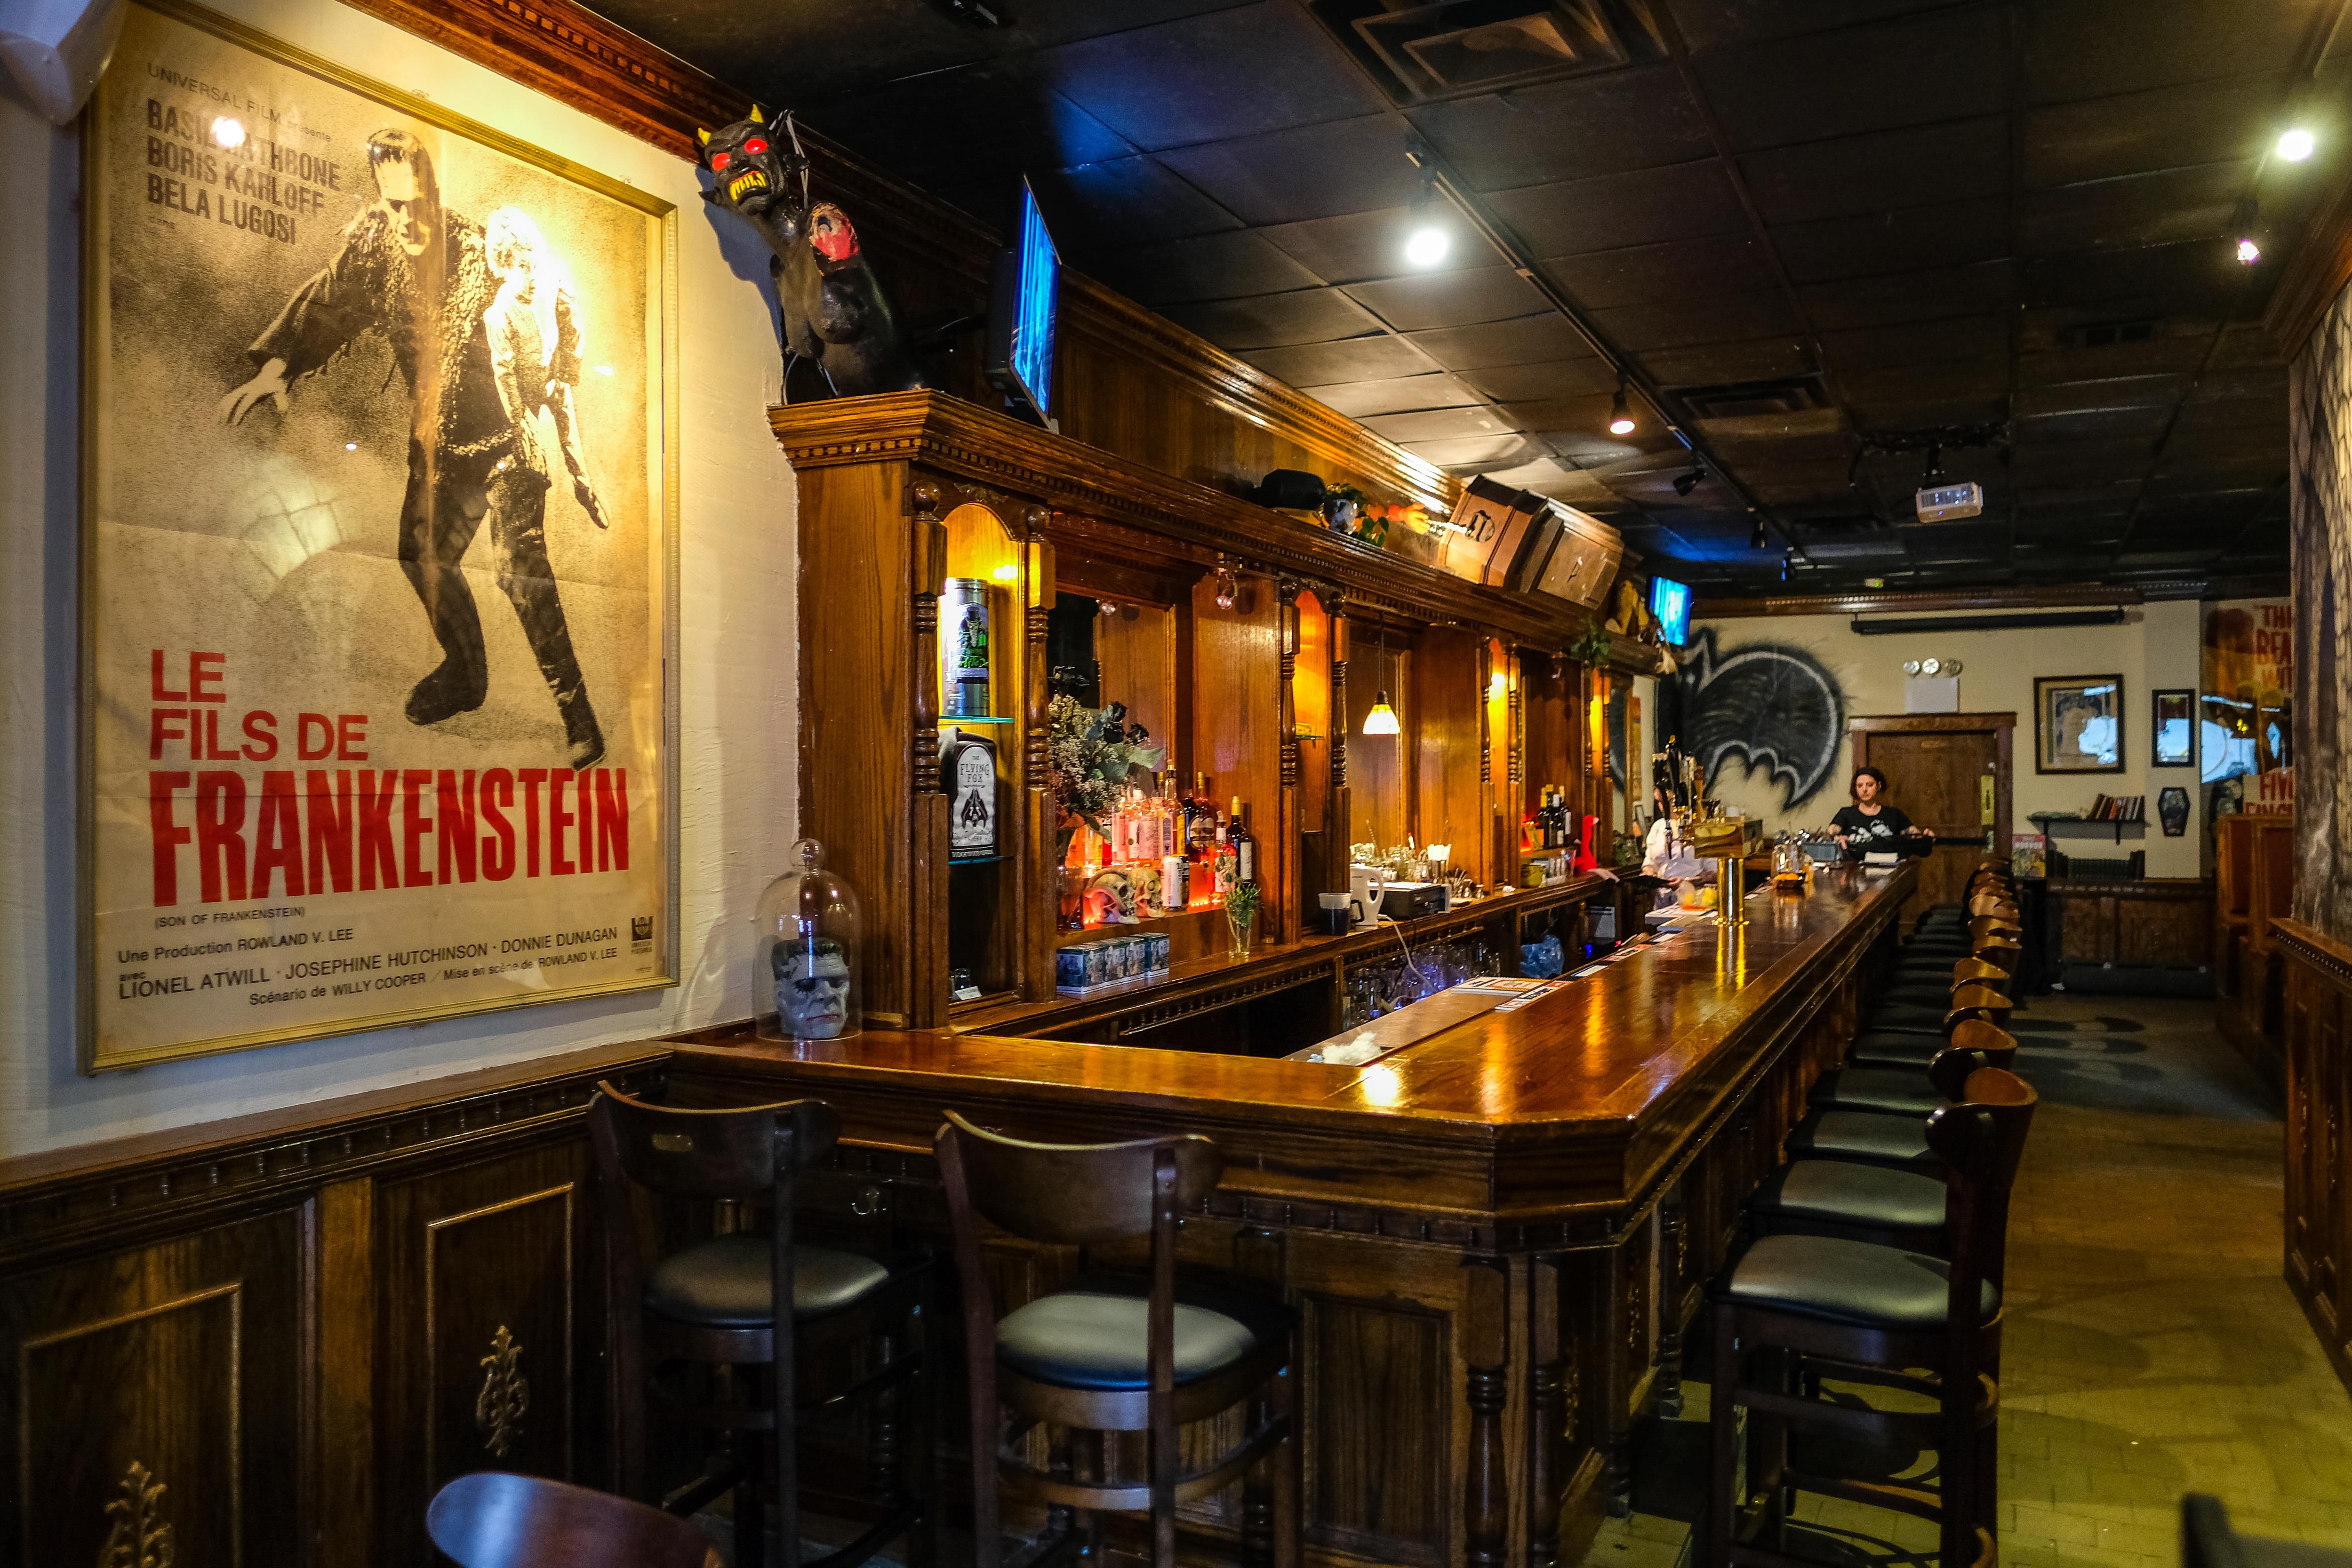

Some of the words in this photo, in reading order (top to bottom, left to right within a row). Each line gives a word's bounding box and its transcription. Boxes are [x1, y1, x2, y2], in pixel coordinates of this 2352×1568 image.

[147, 62, 241, 109] UNIVERSAL
[246, 100, 281, 123] FILM
[147, 98, 218, 150] BASIL
[225, 131, 340, 191] ATHBONE
[148, 135, 218, 185] BORIS
[225, 161, 324, 216] KARLOFF
[148, 172, 211, 219] BELA
[219, 194, 296, 244] LUGOSI
[152, 650, 226, 703] LE
[150, 708, 279, 761] FILS
[298, 713, 368, 761] DE
[960, 763, 989, 776] FLYING
[967, 774, 983, 783] FOX
[149, 768, 629, 907] FRANKENSTEIN
[118, 949, 148, 963] Une
[154, 941, 232, 960] Production
[238, 933, 308, 951] ROWLAND
[312, 931, 324, 943] V.
[329, 928, 353, 942] LEE
[191, 914, 208, 925] OF
[119, 976, 194, 999] LIONEL
[200, 968, 270, 990] ATWILL
[286, 955, 382, 980] JOSEPHINE
[388, 943, 488, 968] HUTCHINSON
[501, 935, 551, 953] DONNIE
[556, 927, 617, 946] DUNAGAN
[249, 987, 306, 1006] Scénario
[311, 986, 326, 998] de
[332, 979, 372, 996] WILLY
[375, 973, 426, 991] COOPER
[443, 968, 469, 980] Mise
[472, 967, 485, 976] en
[488, 961, 519, 975] scène
[521, 959, 533, 970] de
[539, 952, 587, 968] ROWLAND
[589, 951, 599, 961] V.
[601, 948, 617, 960] LEE
